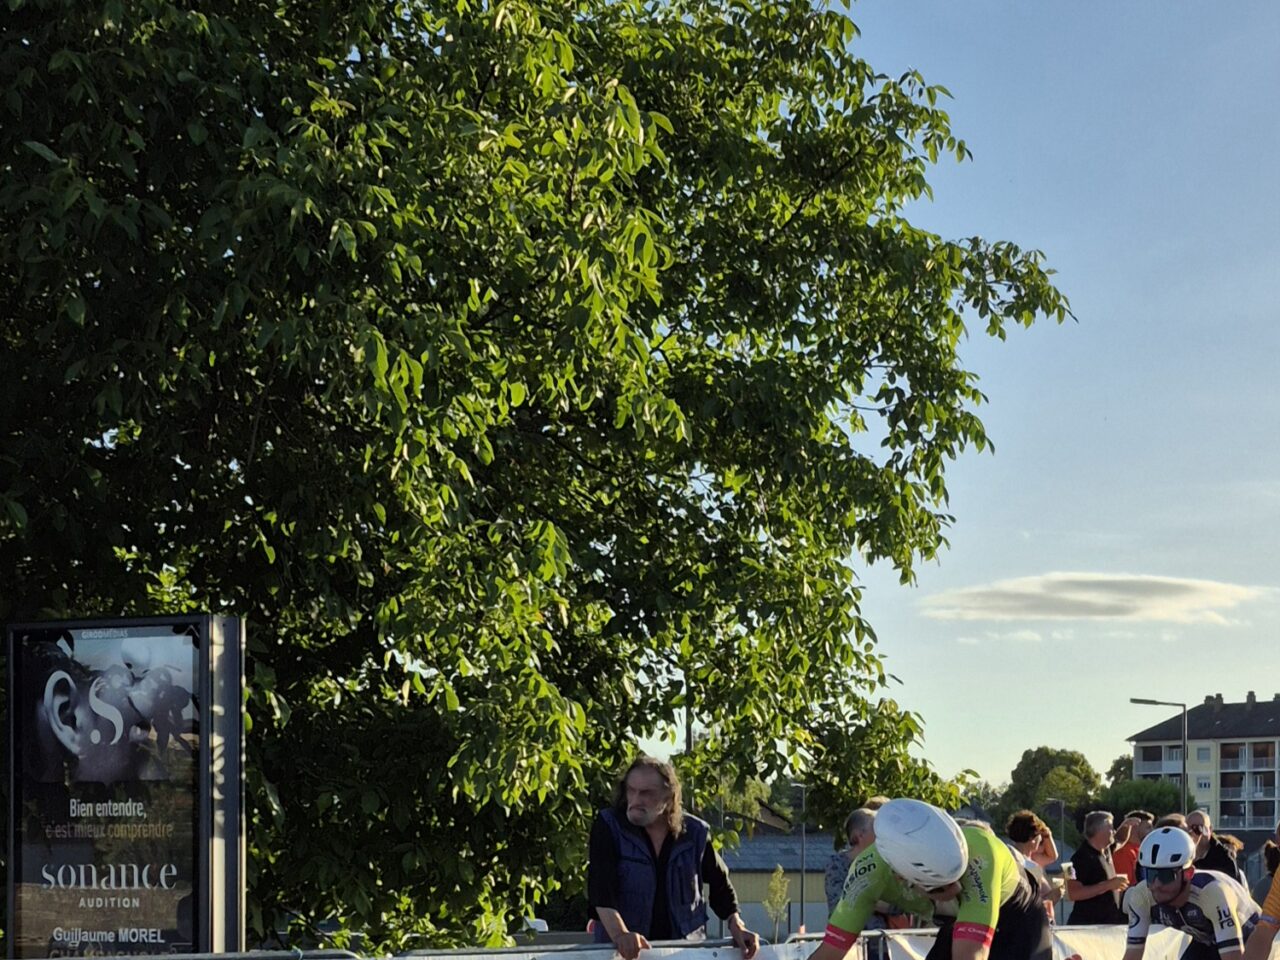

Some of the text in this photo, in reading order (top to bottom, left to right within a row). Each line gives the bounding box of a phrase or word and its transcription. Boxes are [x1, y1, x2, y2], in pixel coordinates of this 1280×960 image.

[69, 797, 148, 820] Bien entendre,
[107, 821, 174, 842] comprendre
[41, 862, 178, 890] sonance
[78, 896, 140, 909] AUDITION
[52, 926, 166, 944] Guillaume MOREL
